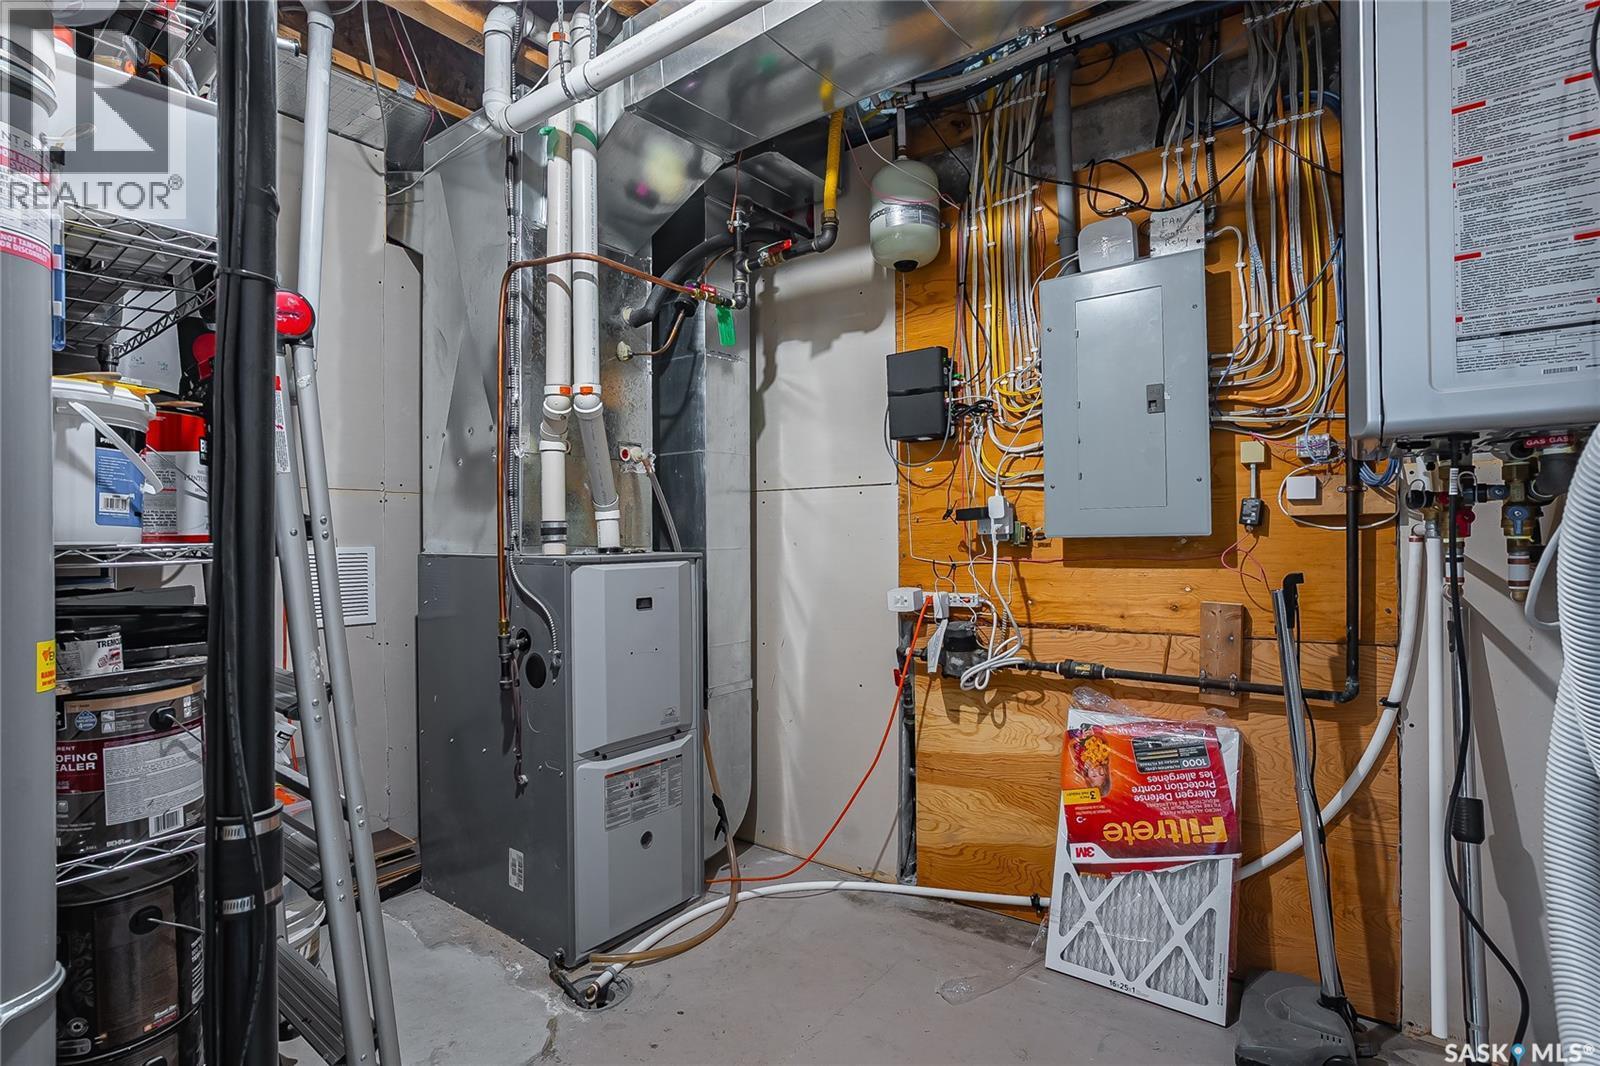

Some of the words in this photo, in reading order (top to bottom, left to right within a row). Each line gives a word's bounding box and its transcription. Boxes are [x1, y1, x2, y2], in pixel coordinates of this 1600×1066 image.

[1161, 217, 1183, 227] FAN
[1526, 438, 1546, 446] GAS
[1548, 436, 1569, 444] GAS
[1182, 758, 1207, 768] 1000
[1146, 772, 1197, 784] allergènes
[1198, 770, 1213, 780] les
[1132, 784, 1162, 794] contre
[1164, 780, 1216, 791] Protection
[1090, 790, 1096, 800] 3
[1134, 793, 1172, 802] Defense
[1175, 789, 1217, 799] Allergen
[1102, 816, 1228, 846] Filtrete
[1076, 847, 1096, 858] 3M
